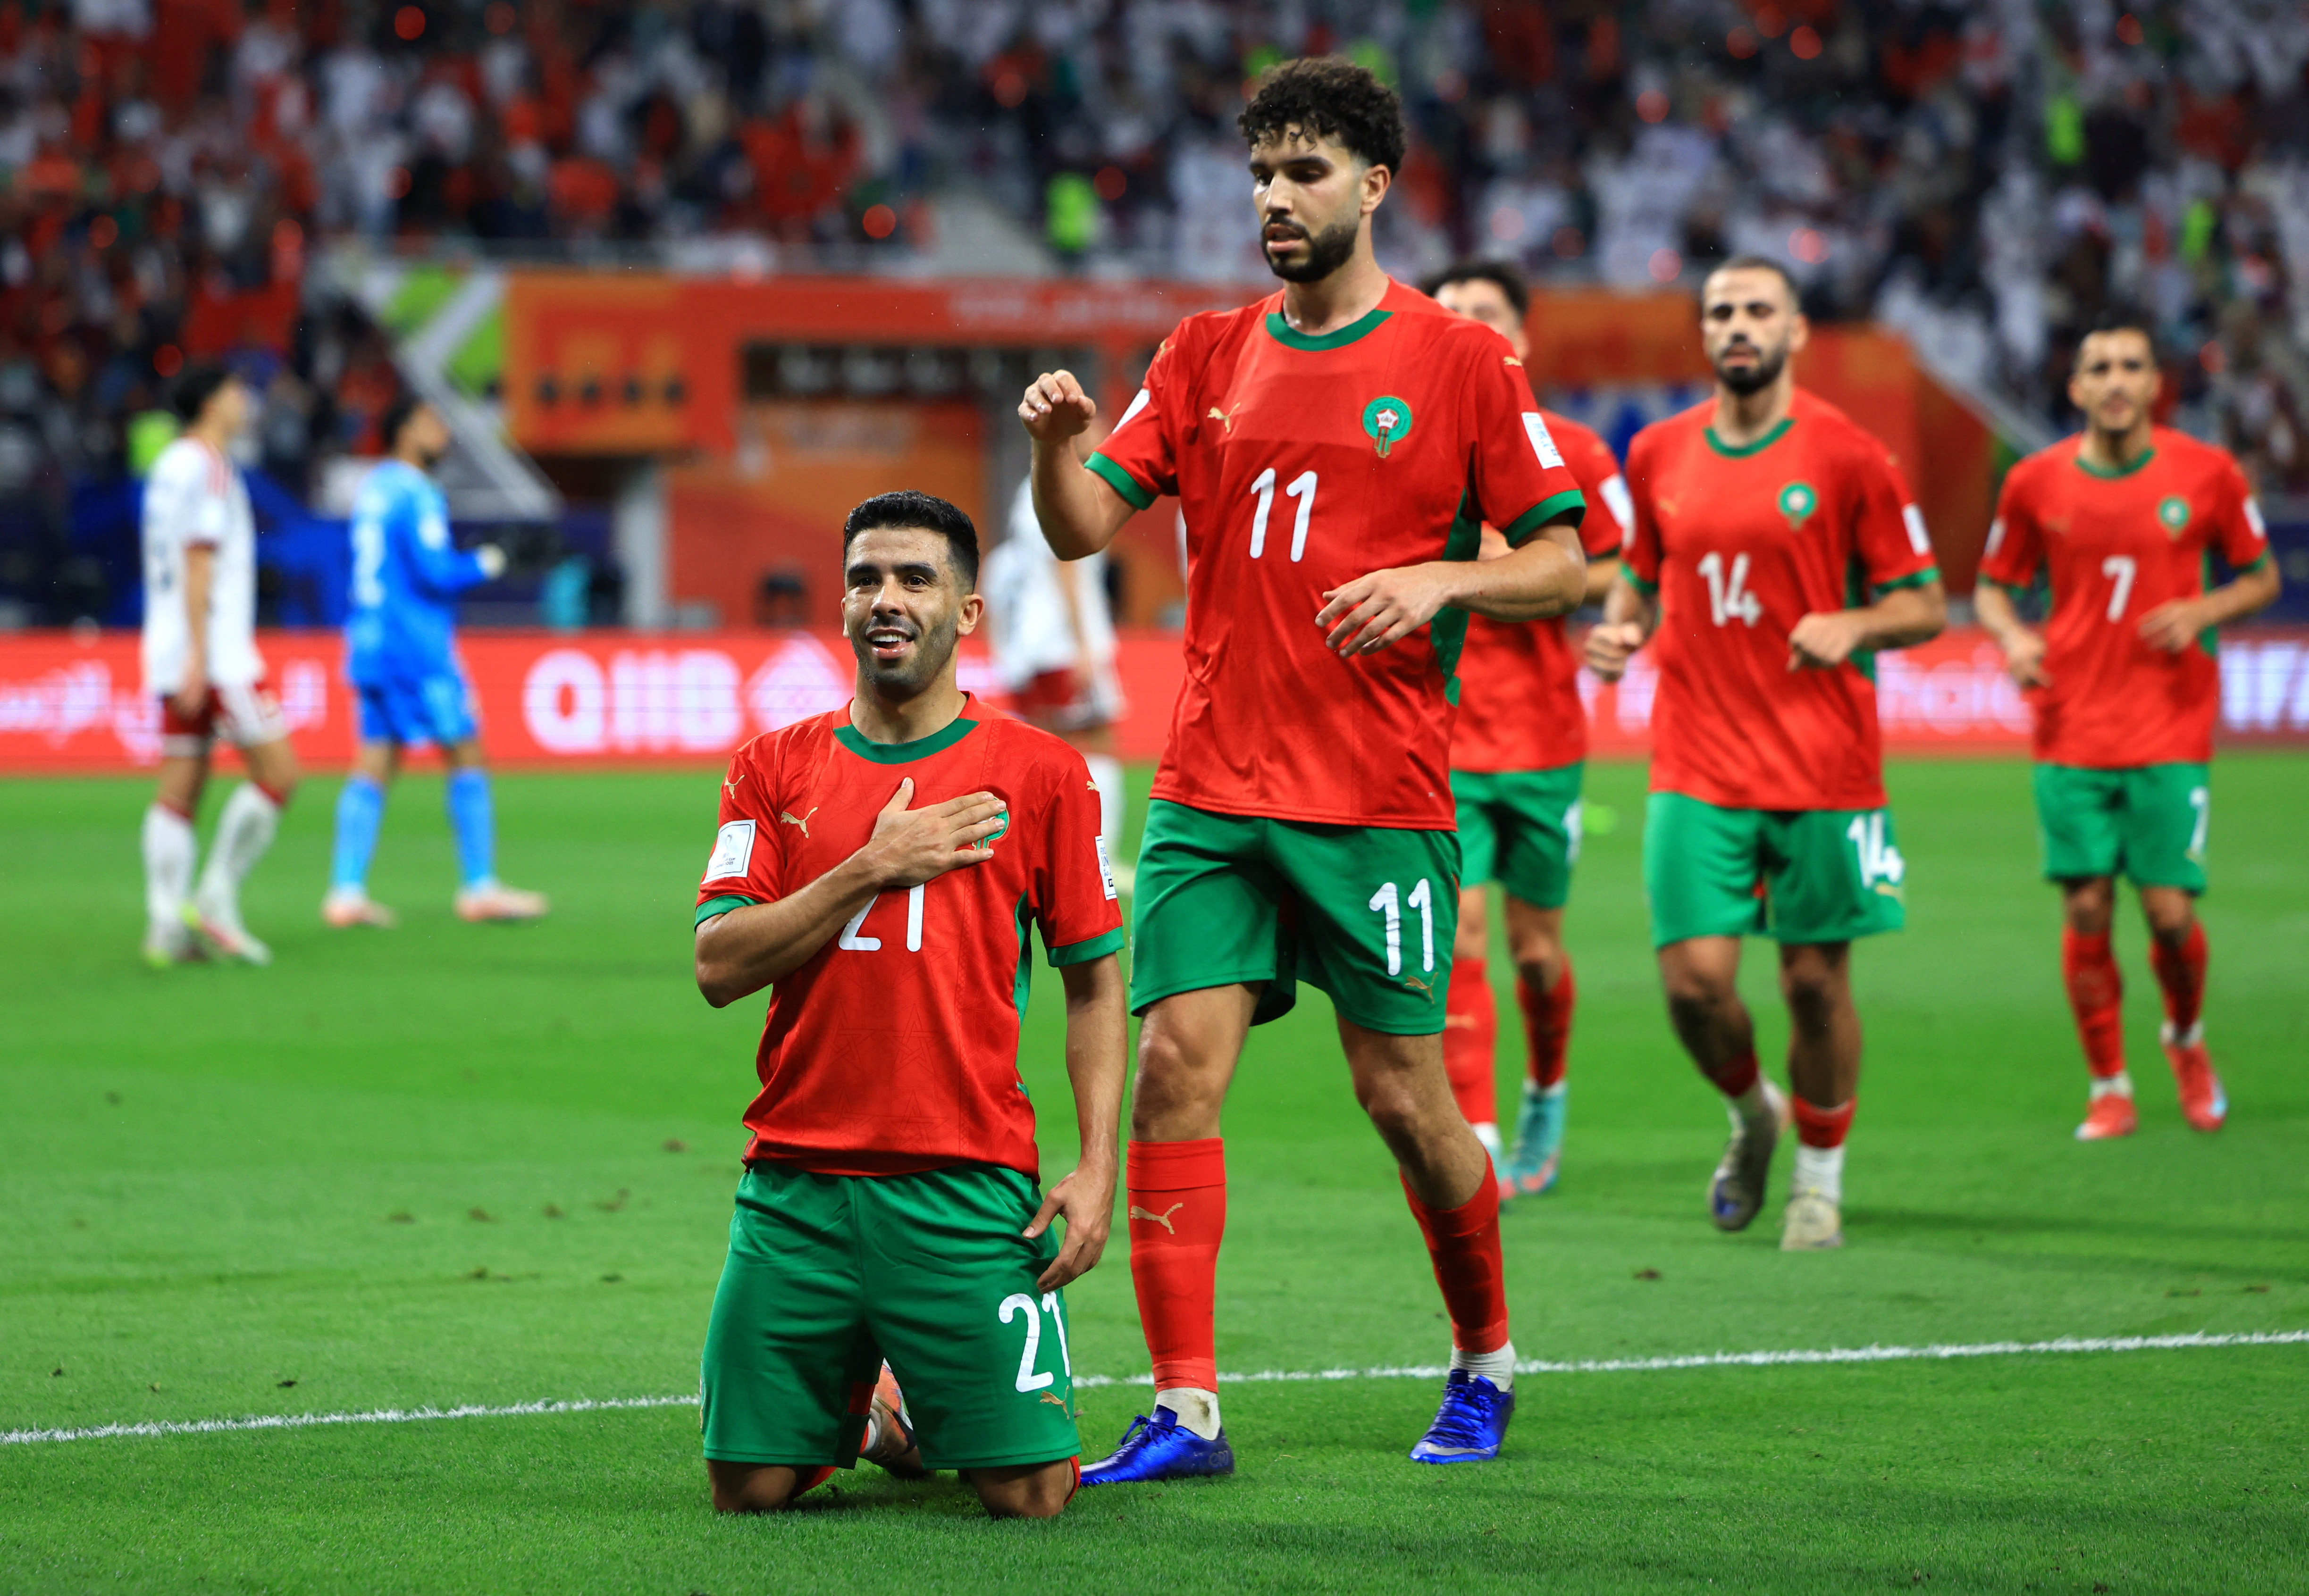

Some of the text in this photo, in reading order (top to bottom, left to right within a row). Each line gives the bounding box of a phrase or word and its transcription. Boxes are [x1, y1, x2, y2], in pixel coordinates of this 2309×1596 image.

[1250, 468, 1318, 562] 11
[1698, 551, 1762, 627] 14
[2103, 555, 2136, 622] 7
[1847, 814, 1905, 888] 14
[1369, 878, 1434, 976] 11
[999, 1291, 1070, 1393] 21
